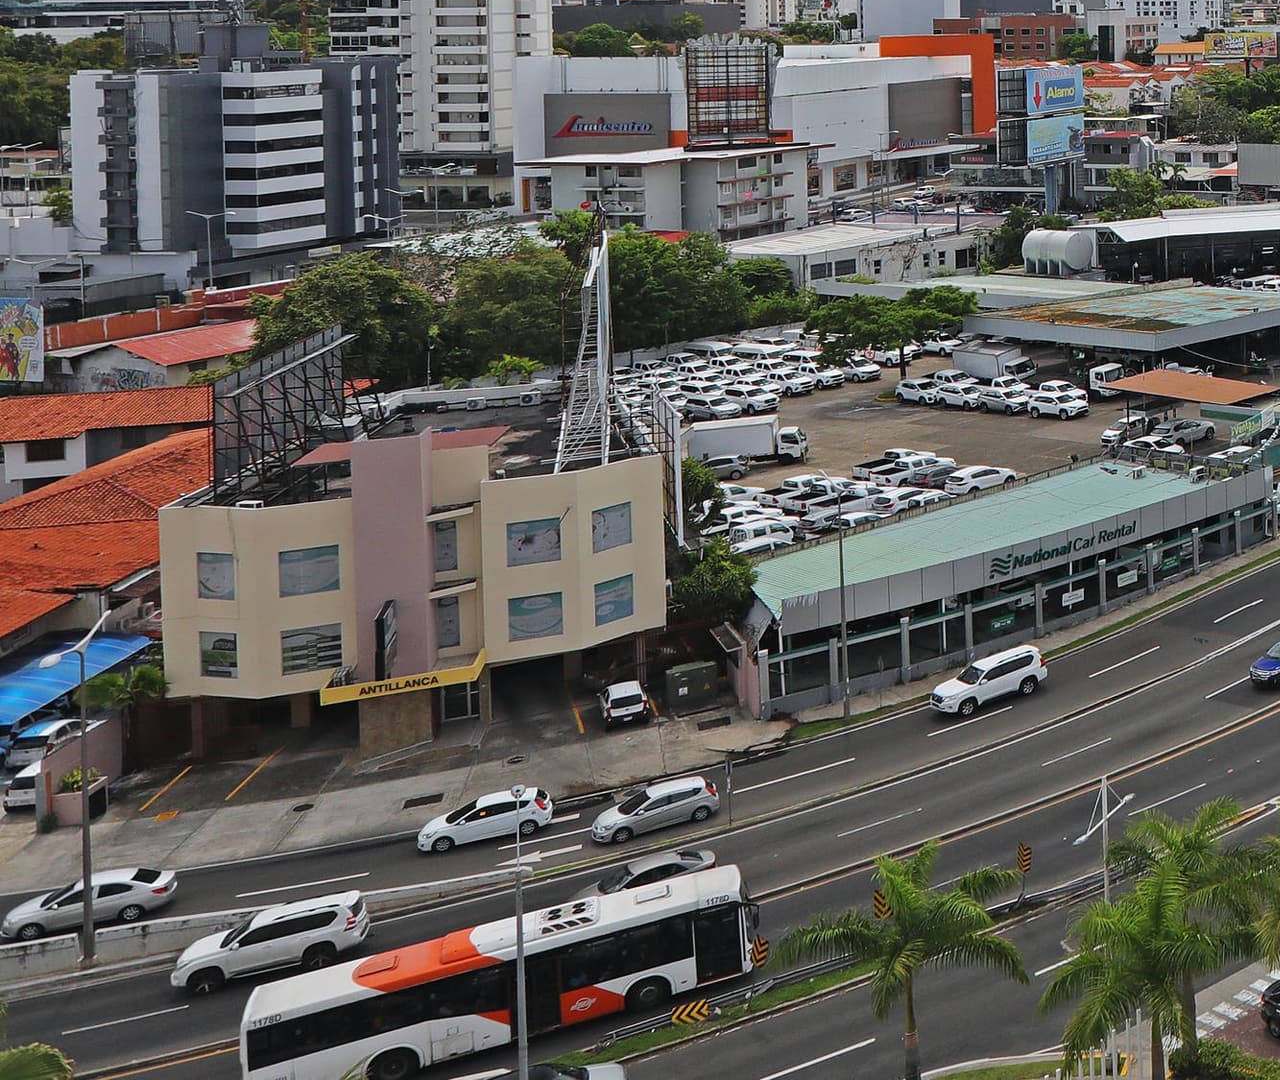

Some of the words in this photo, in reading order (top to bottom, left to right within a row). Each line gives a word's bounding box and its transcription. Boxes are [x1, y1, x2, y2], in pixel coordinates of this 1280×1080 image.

[1046, 86, 1075, 100] Alamo
[1012, 541, 1072, 569] National
[1073, 536, 1095, 552] Car
[1098, 521, 1137, 544] Rental
[359, 676, 440, 696] ANTILLANCA
[252, 1014, 282, 1028] 1178D
